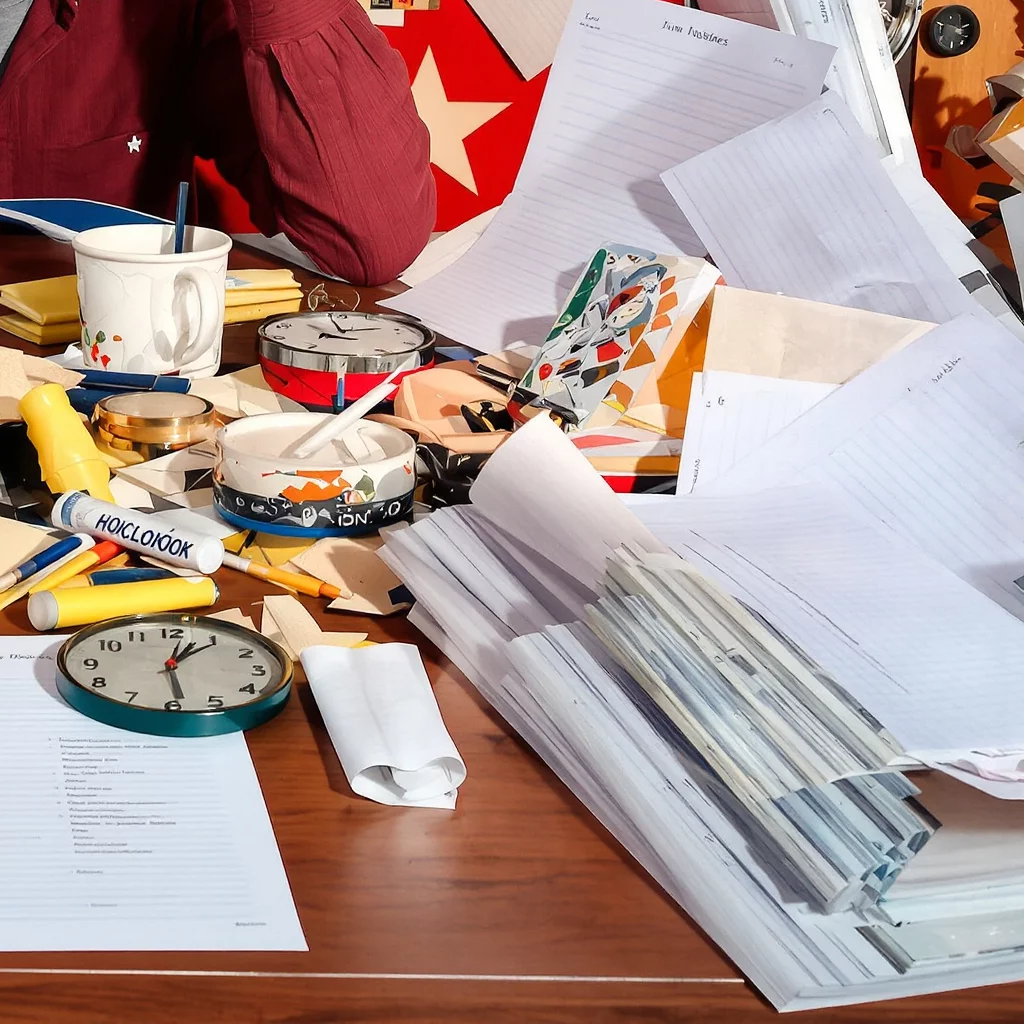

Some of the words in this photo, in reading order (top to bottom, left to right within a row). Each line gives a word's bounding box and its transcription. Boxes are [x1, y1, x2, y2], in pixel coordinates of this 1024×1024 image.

[162, 629, 183, 638] 12
[98, 640, 121, 652] 10
[239, 683, 255, 694] 4
